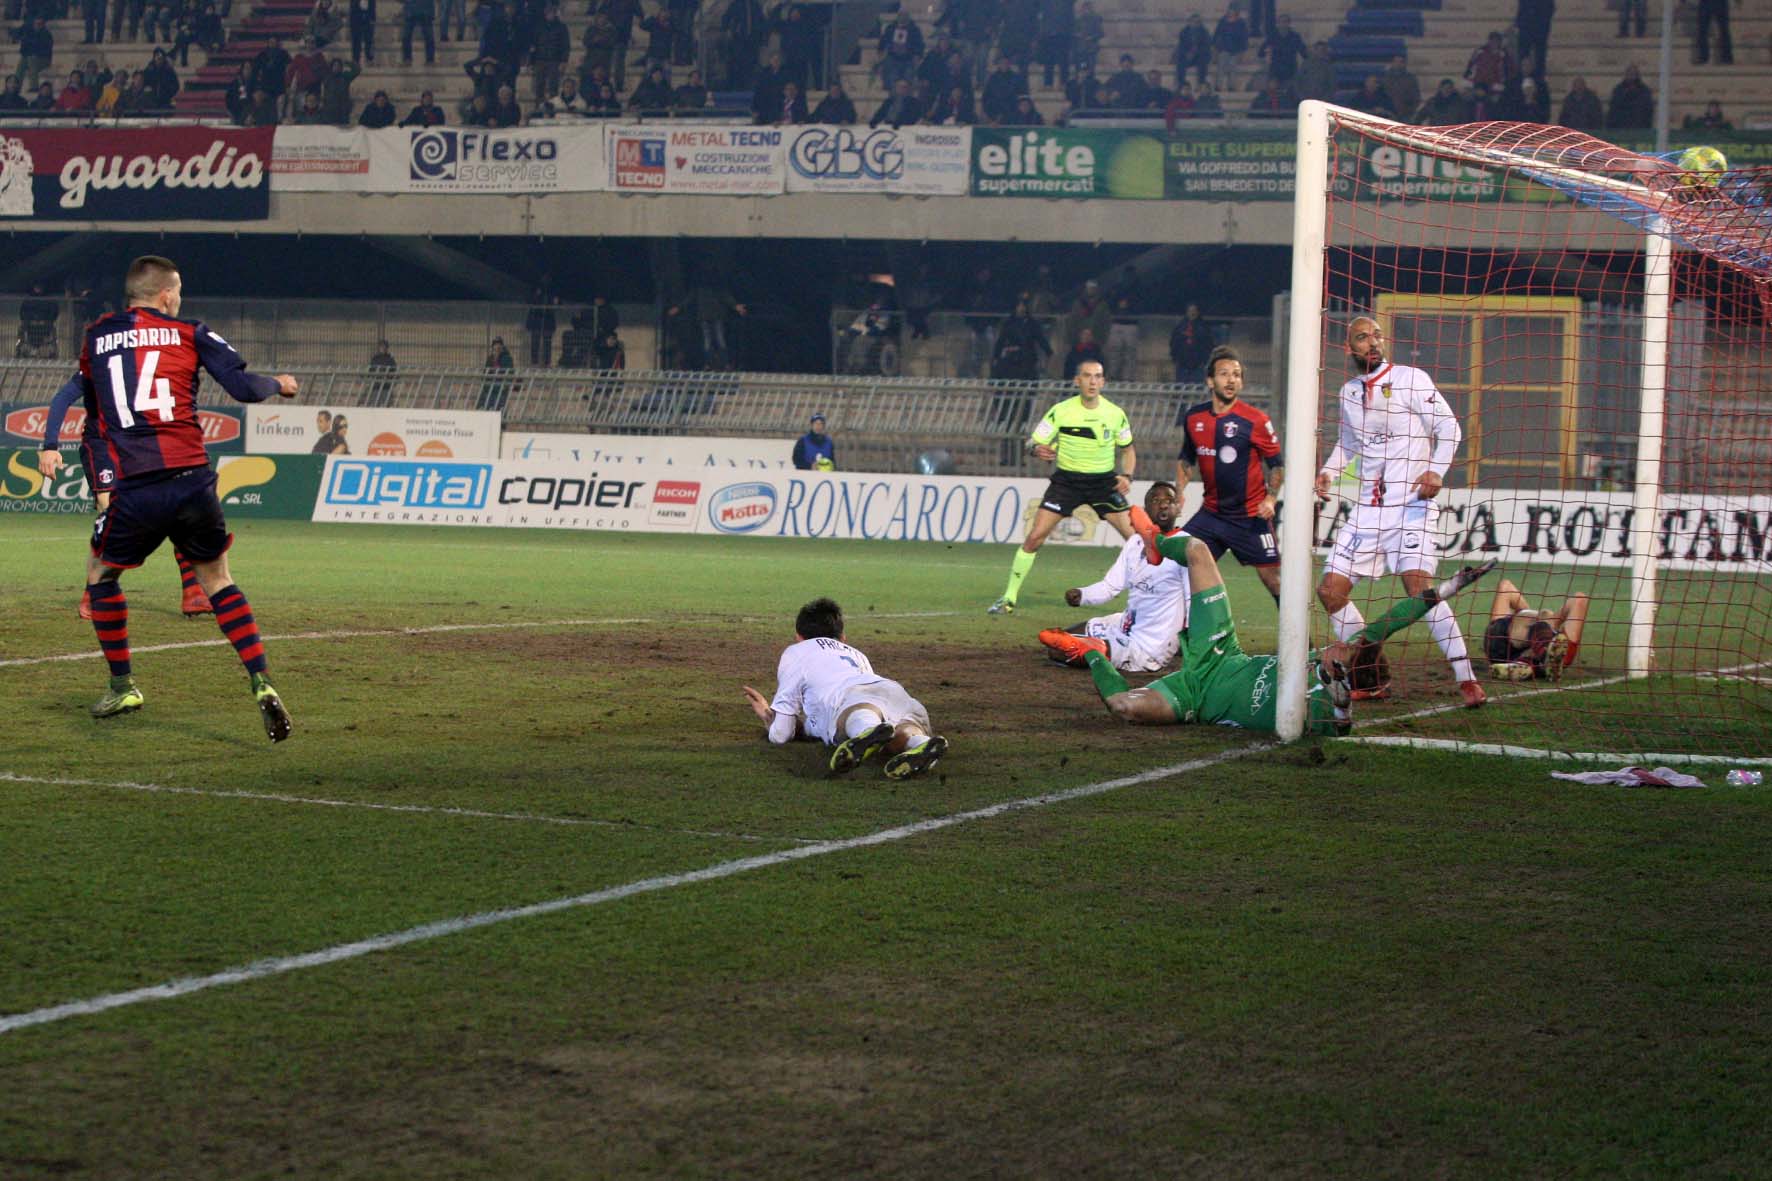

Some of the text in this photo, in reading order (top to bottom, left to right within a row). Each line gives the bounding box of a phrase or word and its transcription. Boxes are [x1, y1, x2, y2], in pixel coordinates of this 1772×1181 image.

[462, 133, 558, 161] Flexo
[979, 131, 1096, 176] elite
[1170, 142, 1221, 157] ELITE
[59, 139, 263, 209] guardia
[459, 164, 558, 182] service
[617, 172, 664, 186] TECNO
[979, 177, 1096, 195] supermercati
[96, 327, 181, 355] RAPISARDA
[107, 350, 176, 429] 14
[255, 421, 305, 436] linkem
[328, 463, 488, 507] Digital
[498, 471, 647, 511] copier
[656, 488, 698, 499] RICOH
[334, 510, 498, 525] INTEGRAZIONE
[510, 515, 631, 528] IN UFFICIO
[721, 503, 769, 523] Motta
[777, 478, 1021, 545] RONCAROLO
[1260, 534, 1275, 549] 10
[1251, 656, 1277, 708] OLACEM
